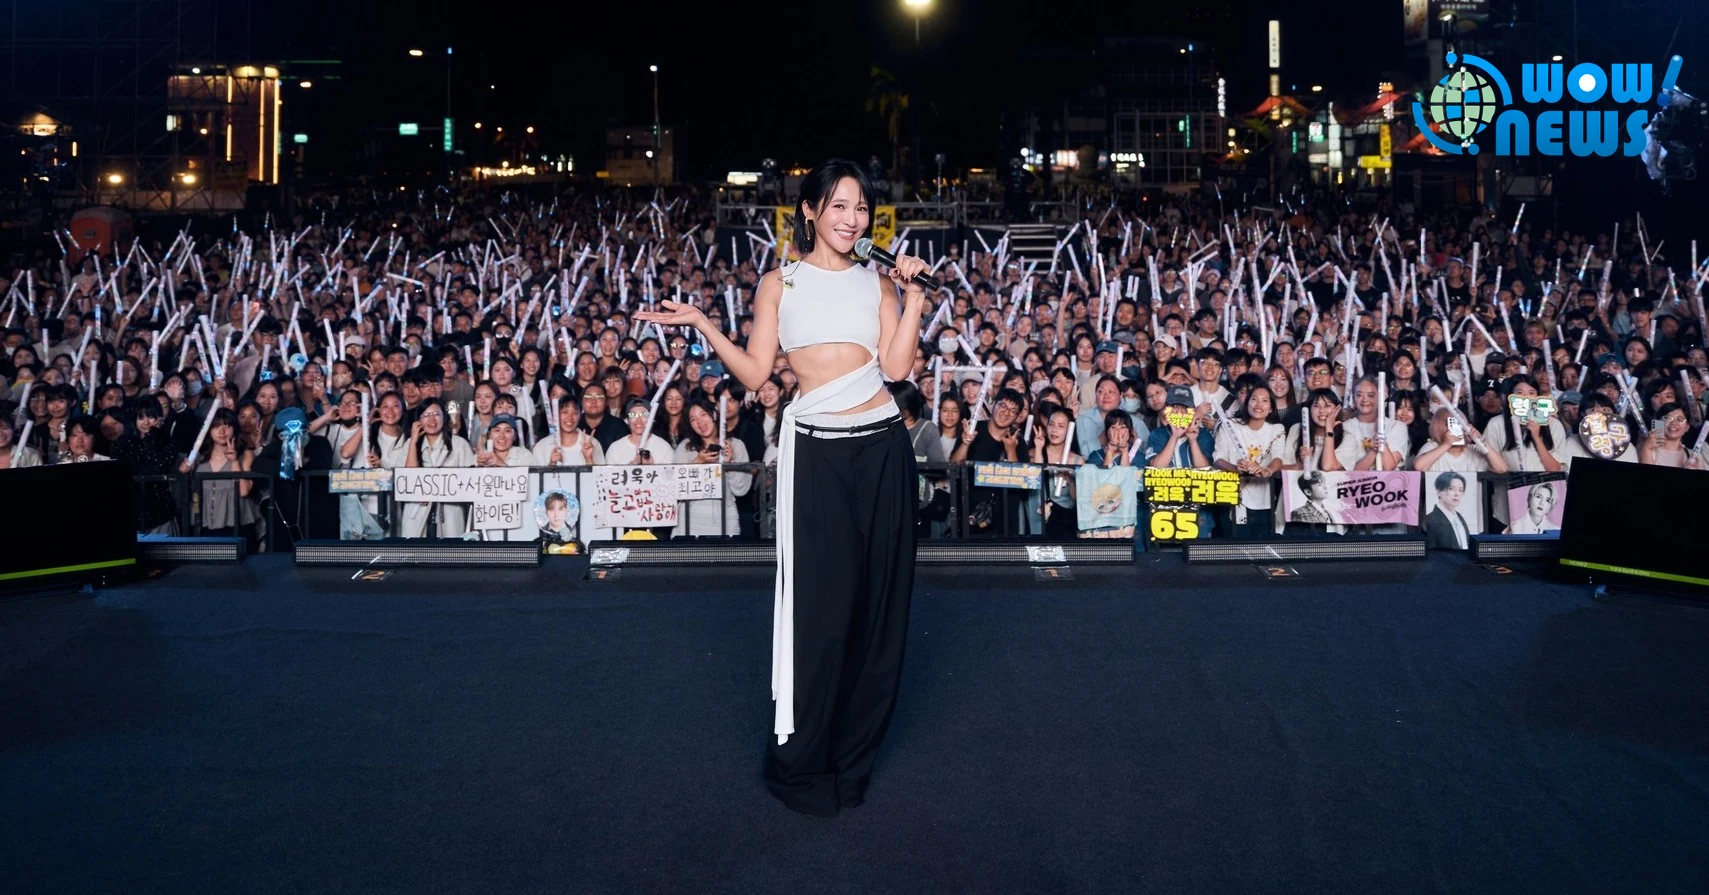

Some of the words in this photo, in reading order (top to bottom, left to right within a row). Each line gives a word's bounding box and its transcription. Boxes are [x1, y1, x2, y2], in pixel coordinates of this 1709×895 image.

[611, 468, 658, 486] 려욱아
[1151, 469, 1173, 478] LOOK
[1337, 479, 1356, 487] SUPER
[1337, 481, 1386, 499] RYEO
[1154, 486, 1184, 502] 려욱
[1192, 480, 1239, 505] 려욱
[1355, 490, 1409, 508] WOOK
[475, 503, 520, 524] 화이팅!
[640, 502, 676, 521] 사랑해
[1151, 511, 1198, 540] 65
